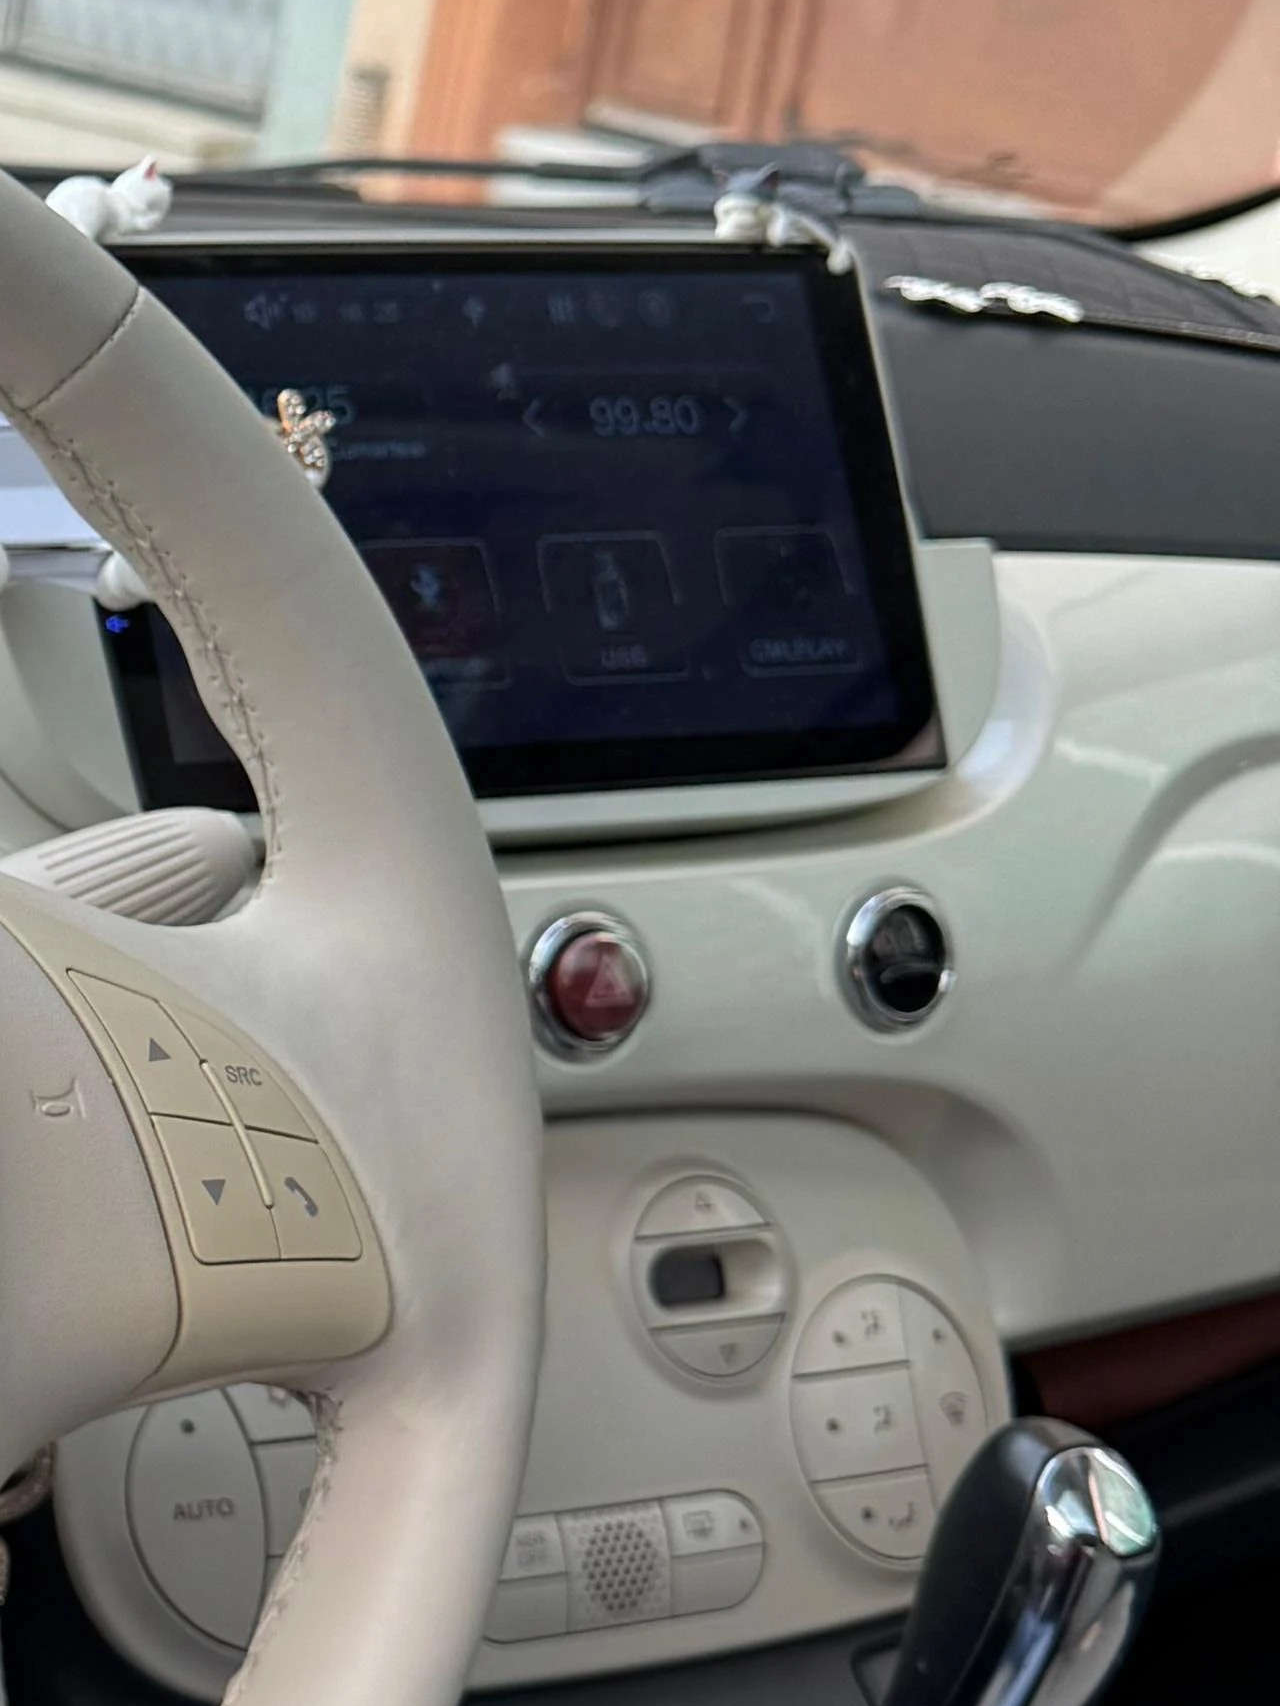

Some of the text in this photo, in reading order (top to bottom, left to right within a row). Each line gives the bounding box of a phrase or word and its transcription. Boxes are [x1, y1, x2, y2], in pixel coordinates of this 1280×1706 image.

[589, 395, 703, 436] 99.80
[224, 1065, 263, 1088] SRC
[173, 1496, 236, 1521] AUTO
